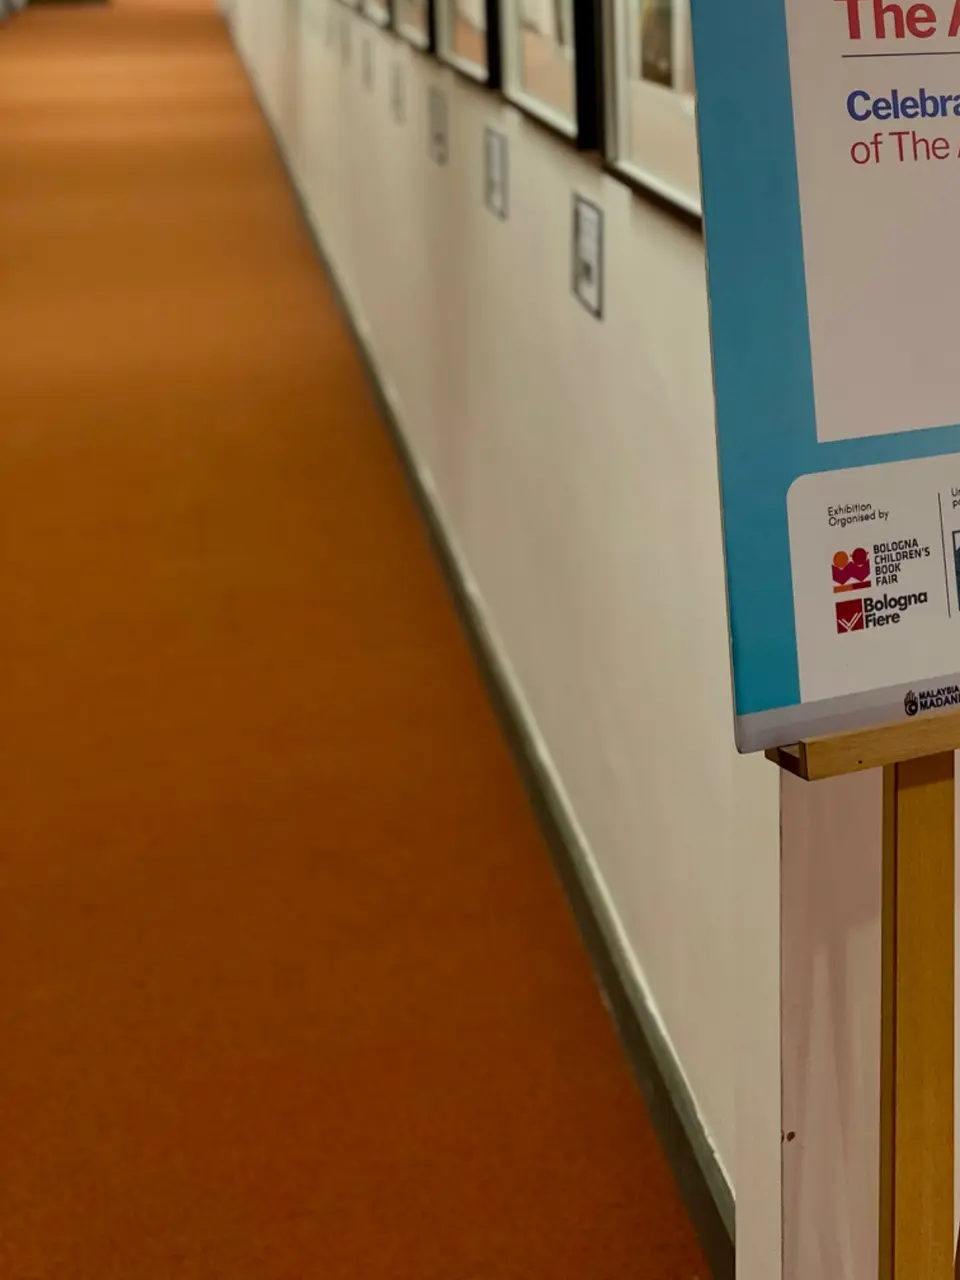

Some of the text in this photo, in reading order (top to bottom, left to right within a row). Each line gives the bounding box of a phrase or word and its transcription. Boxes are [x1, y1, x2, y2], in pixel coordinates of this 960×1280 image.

[849, 133, 883, 165] of
[890, 131, 951, 162] The
[827, 502, 872, 517] Exhibition
[828, 509, 890, 528] Organised by
[873, 538, 919, 555] BOLOGNA
[874, 547, 931, 565] CHILDREN'S
[875, 563, 901, 576] BOOK
[876, 574, 898, 587] FAIR
[863, 591, 928, 613] Bologna
[865, 612, 900, 629] Fiere
[918, 685, 960, 700] MALAYSIA
[919, 693, 960, 711] MADANI
